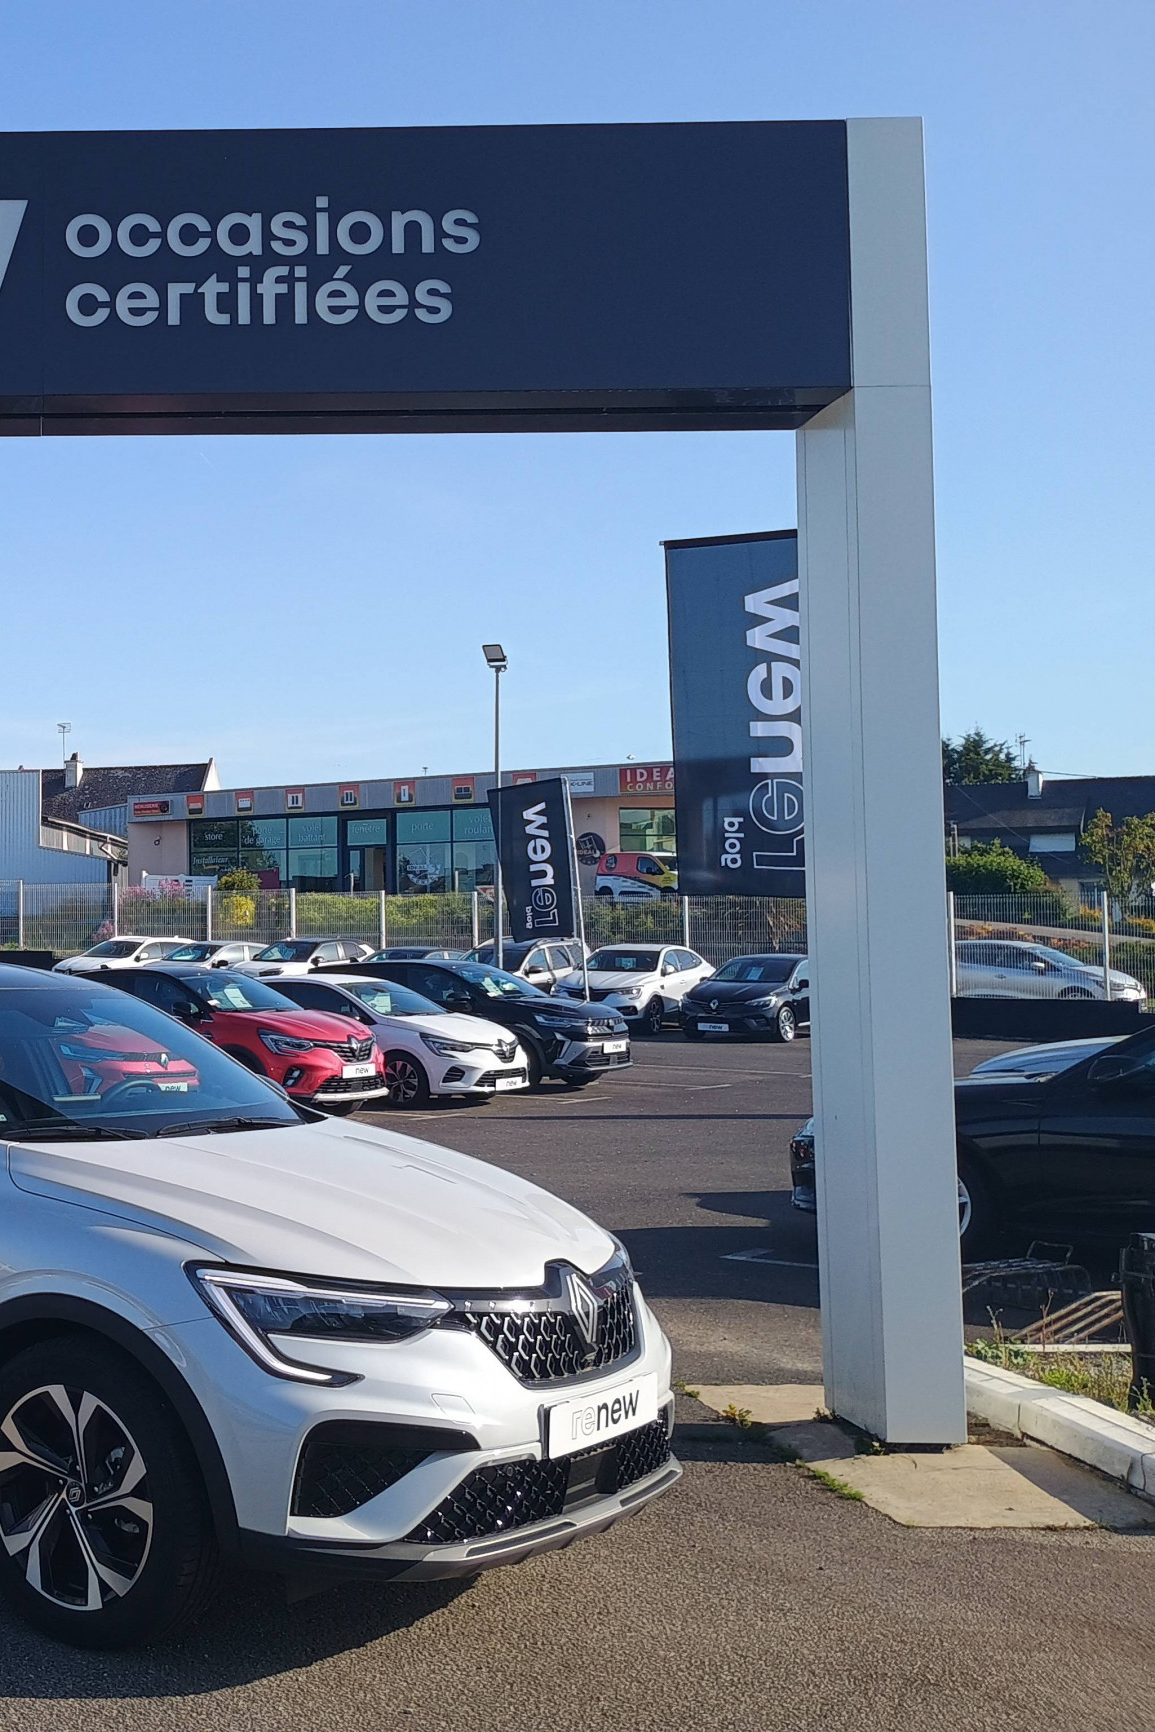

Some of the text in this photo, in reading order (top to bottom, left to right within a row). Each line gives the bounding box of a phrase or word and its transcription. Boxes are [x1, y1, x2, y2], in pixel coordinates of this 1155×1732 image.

[64, 195, 482, 258] occasions
[64, 265, 454, 327] certifiées
[204, 831, 223, 841] store
[244, 835, 254, 845] de
[570, 1389, 640, 1441] renew
